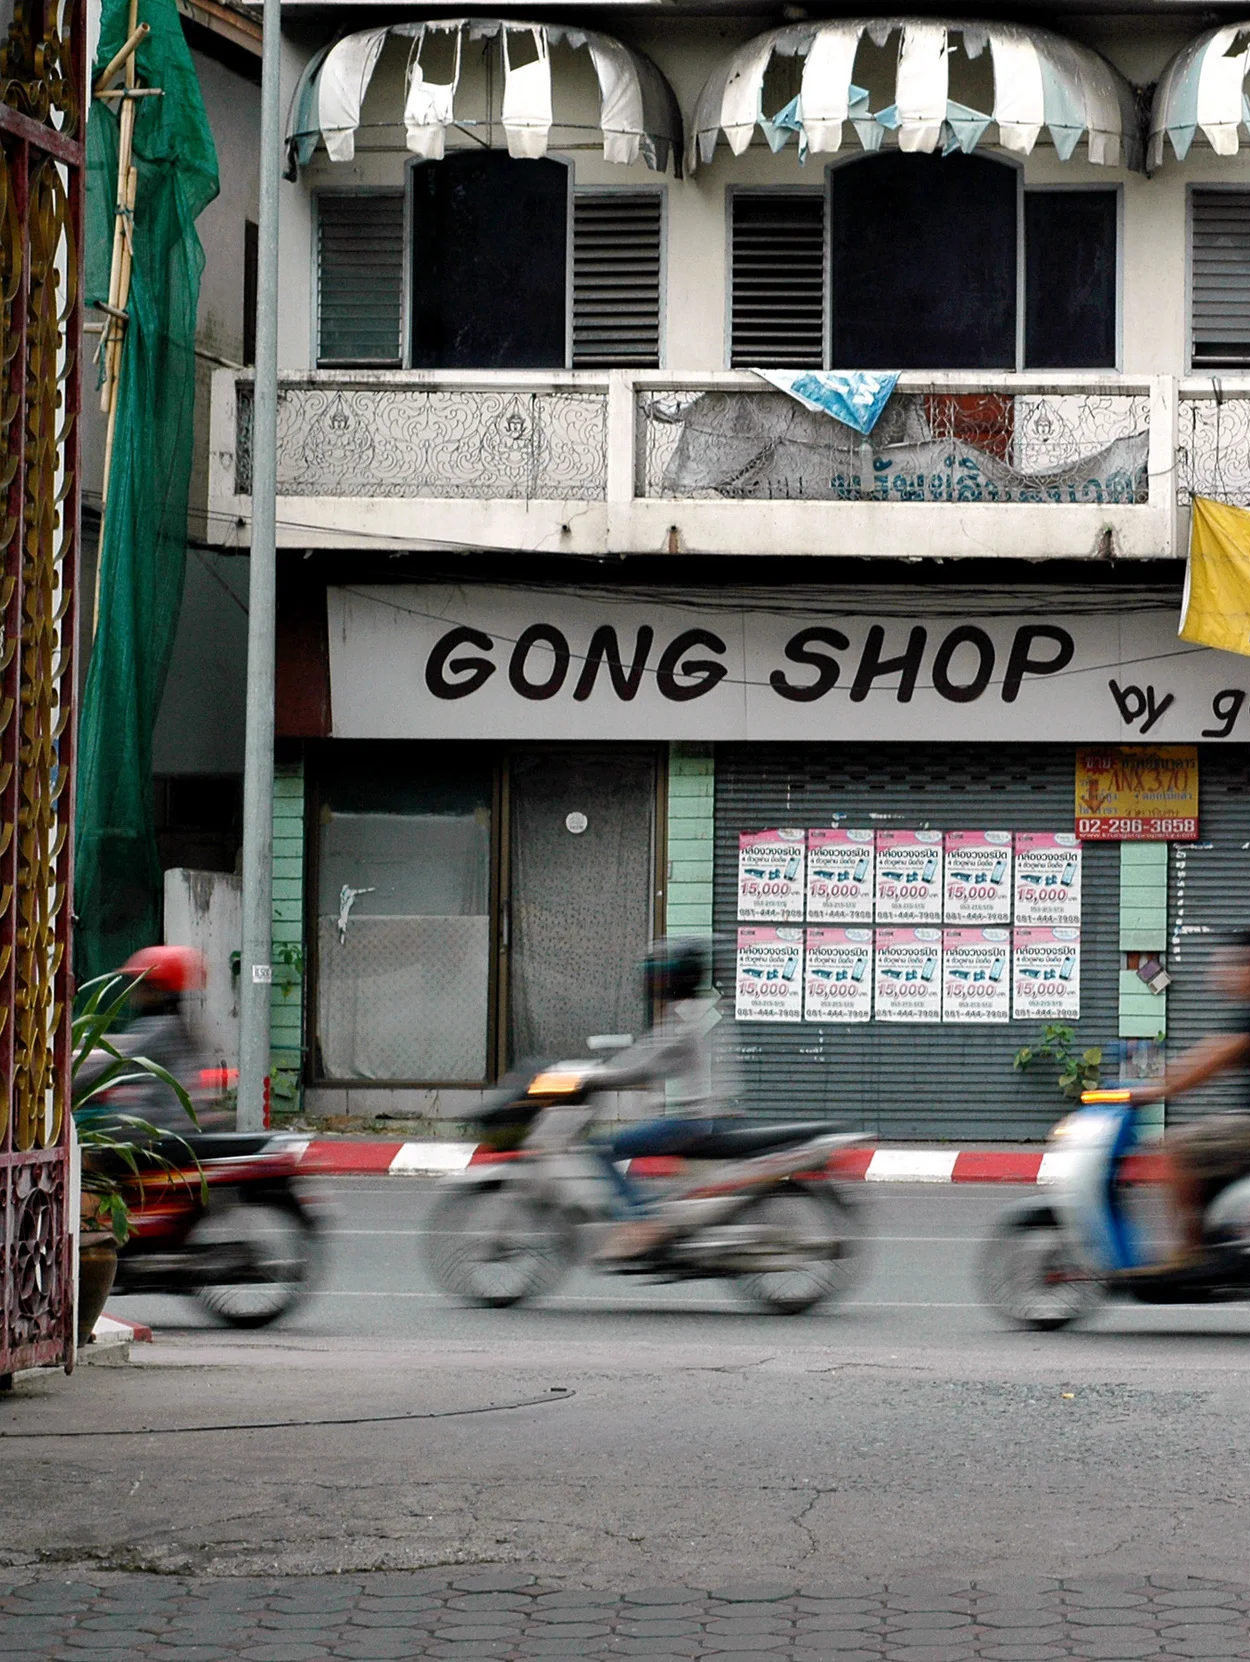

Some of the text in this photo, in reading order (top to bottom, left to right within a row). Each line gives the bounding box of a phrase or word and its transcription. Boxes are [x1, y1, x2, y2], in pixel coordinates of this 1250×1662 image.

[425, 623, 1076, 703] GONG SHOP
[1108, 679, 1174, 734] by
[1079, 818, 1195, 833] 02-296-3658
[742, 883, 790, 897] 15,000
[810, 884, 859, 898] 15,000
[879, 885, 928, 900] 15,000
[948, 886, 997, 900] 15,000
[1018, 888, 1067, 903] 15,000
[739, 983, 788, 997] 15,000
[809, 984, 857, 998] 15,000
[878, 984, 927, 998] 15,000
[947, 984, 995, 998] 15,000
[1016, 982, 1066, 996] 15,000
